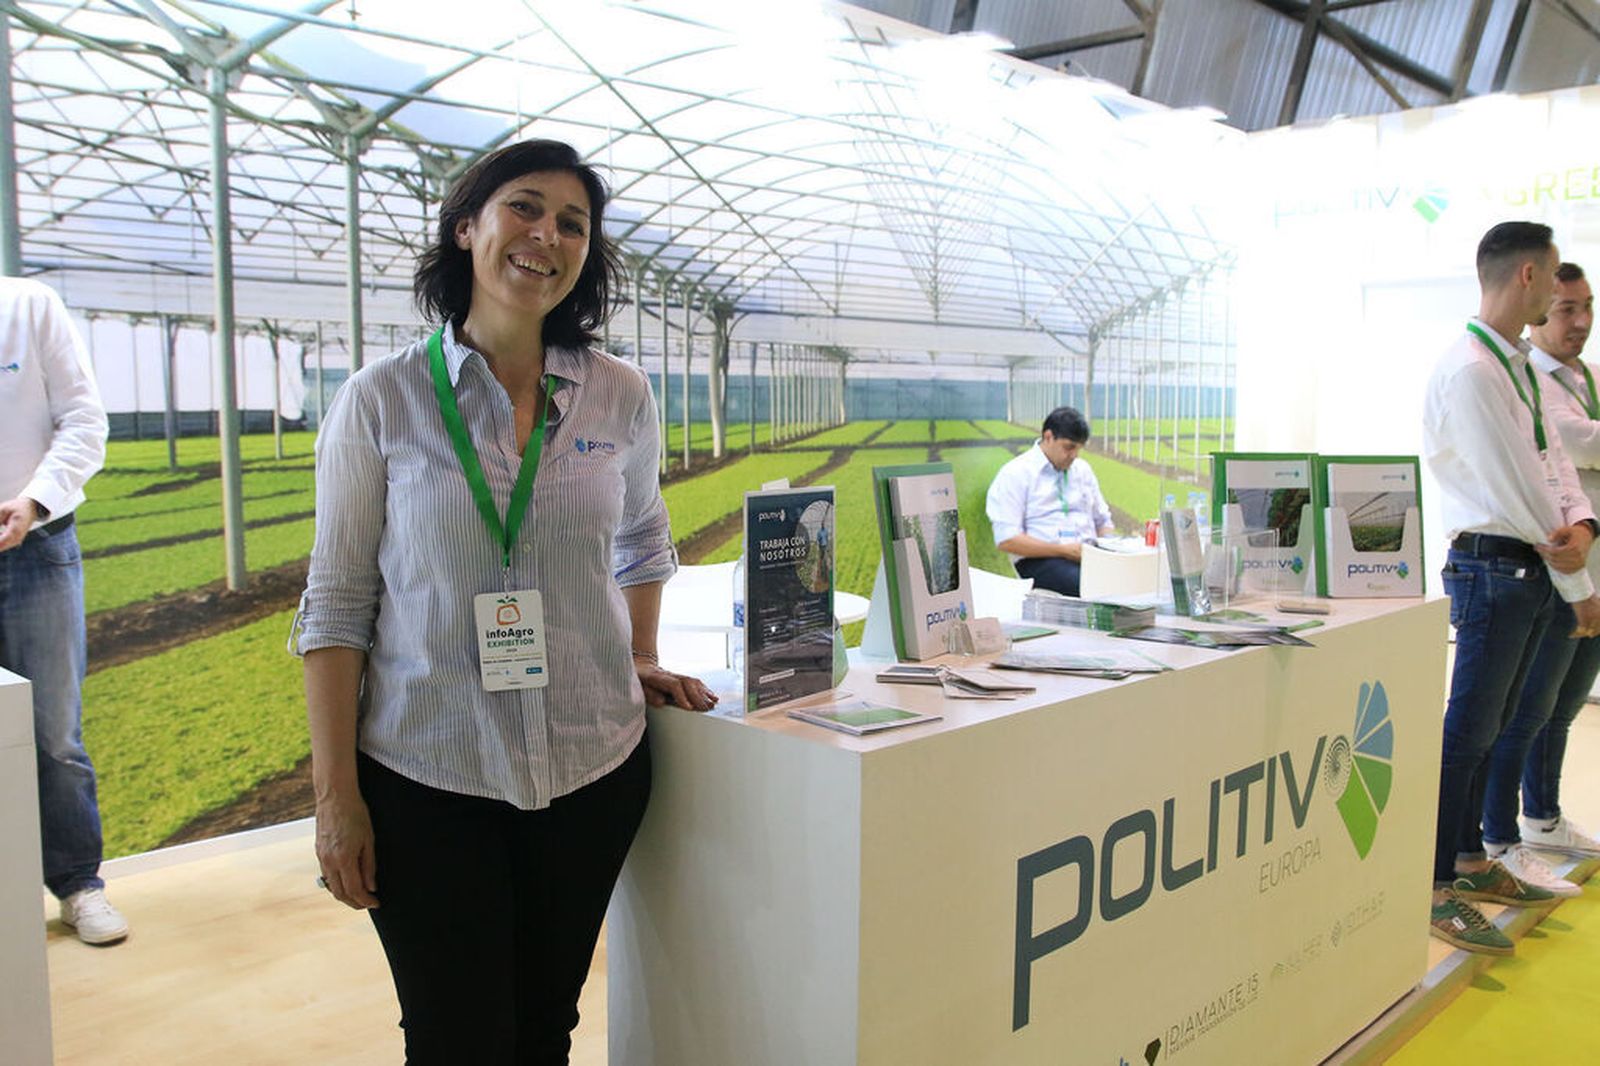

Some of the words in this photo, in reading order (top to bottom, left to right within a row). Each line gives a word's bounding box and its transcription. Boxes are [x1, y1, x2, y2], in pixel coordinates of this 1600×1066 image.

[759, 538, 790, 550] TRABAJA
[790, 535, 806, 547] CON
[759, 547, 806, 562] NOSOTROS
[486, 627, 534, 640] infoAgro
[487, 637, 535, 649] EXHIBITION
[1258, 837, 1322, 894] EUROPA
[1169, 982, 1243, 1046] DIAMANTE
[1246, 971, 1260, 995] 15
